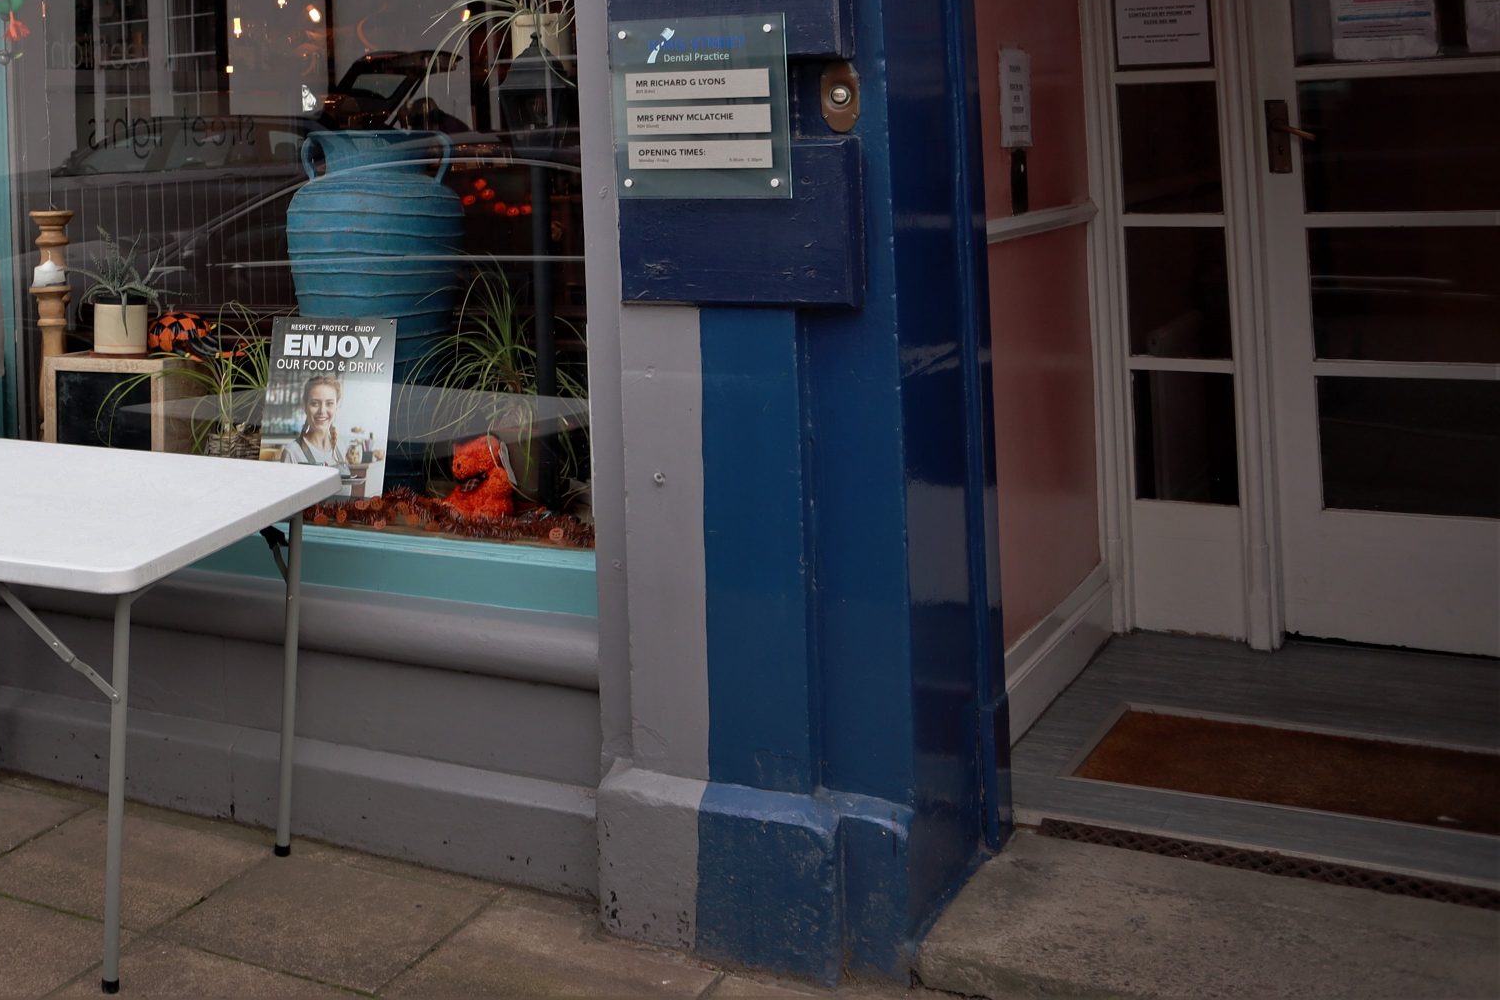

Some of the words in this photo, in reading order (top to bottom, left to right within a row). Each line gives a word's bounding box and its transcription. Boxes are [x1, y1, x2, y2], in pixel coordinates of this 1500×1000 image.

[663, 52, 693, 63] Dental
[694, 51, 730, 62] Practice
[635, 80, 649, 88] MR
[650, 78, 687, 87] RICHARD
[689, 78, 696, 86] G
[698, 77, 726, 85] LYONS
[637, 114, 654, 122] MRS
[656, 113, 684, 122] PENNY
[686, 112, 734, 121] MCLATCHIE
[638, 149, 677, 157] OPENING
[679, 148, 706, 156] TIMES:
[354, 325, 376, 333] ENJOY
[283, 333, 382, 359] ENJOY
[276, 358, 300, 370] OUR
[302, 359, 334, 371] FOOD
[337, 360, 346, 372] &
[348, 361, 385, 373] DRINK
